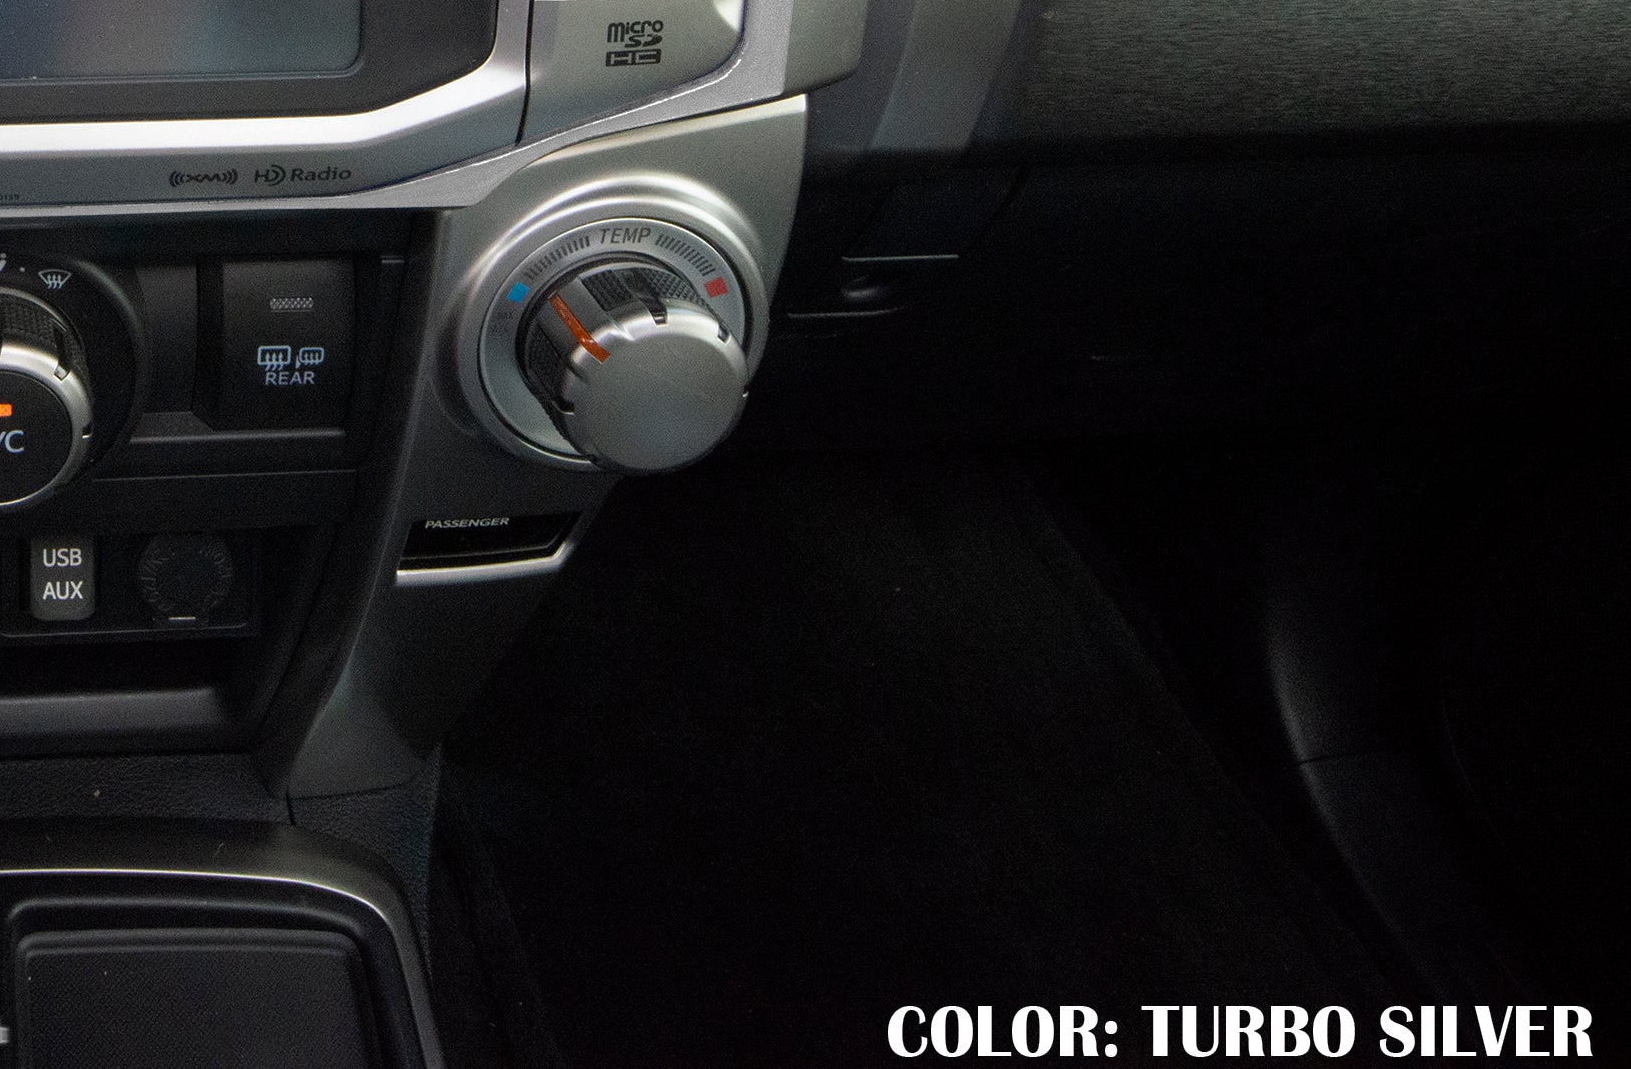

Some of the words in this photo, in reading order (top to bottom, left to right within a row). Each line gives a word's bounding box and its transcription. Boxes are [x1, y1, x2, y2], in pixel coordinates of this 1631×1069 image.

[290, 166, 352, 181] Radio
[599, 227, 651, 244] TEMP
[264, 371, 315, 385] REAR
[424, 517, 510, 529] PASSENGER
[41, 548, 83, 566] USB
[41, 582, 84, 600] AUX
